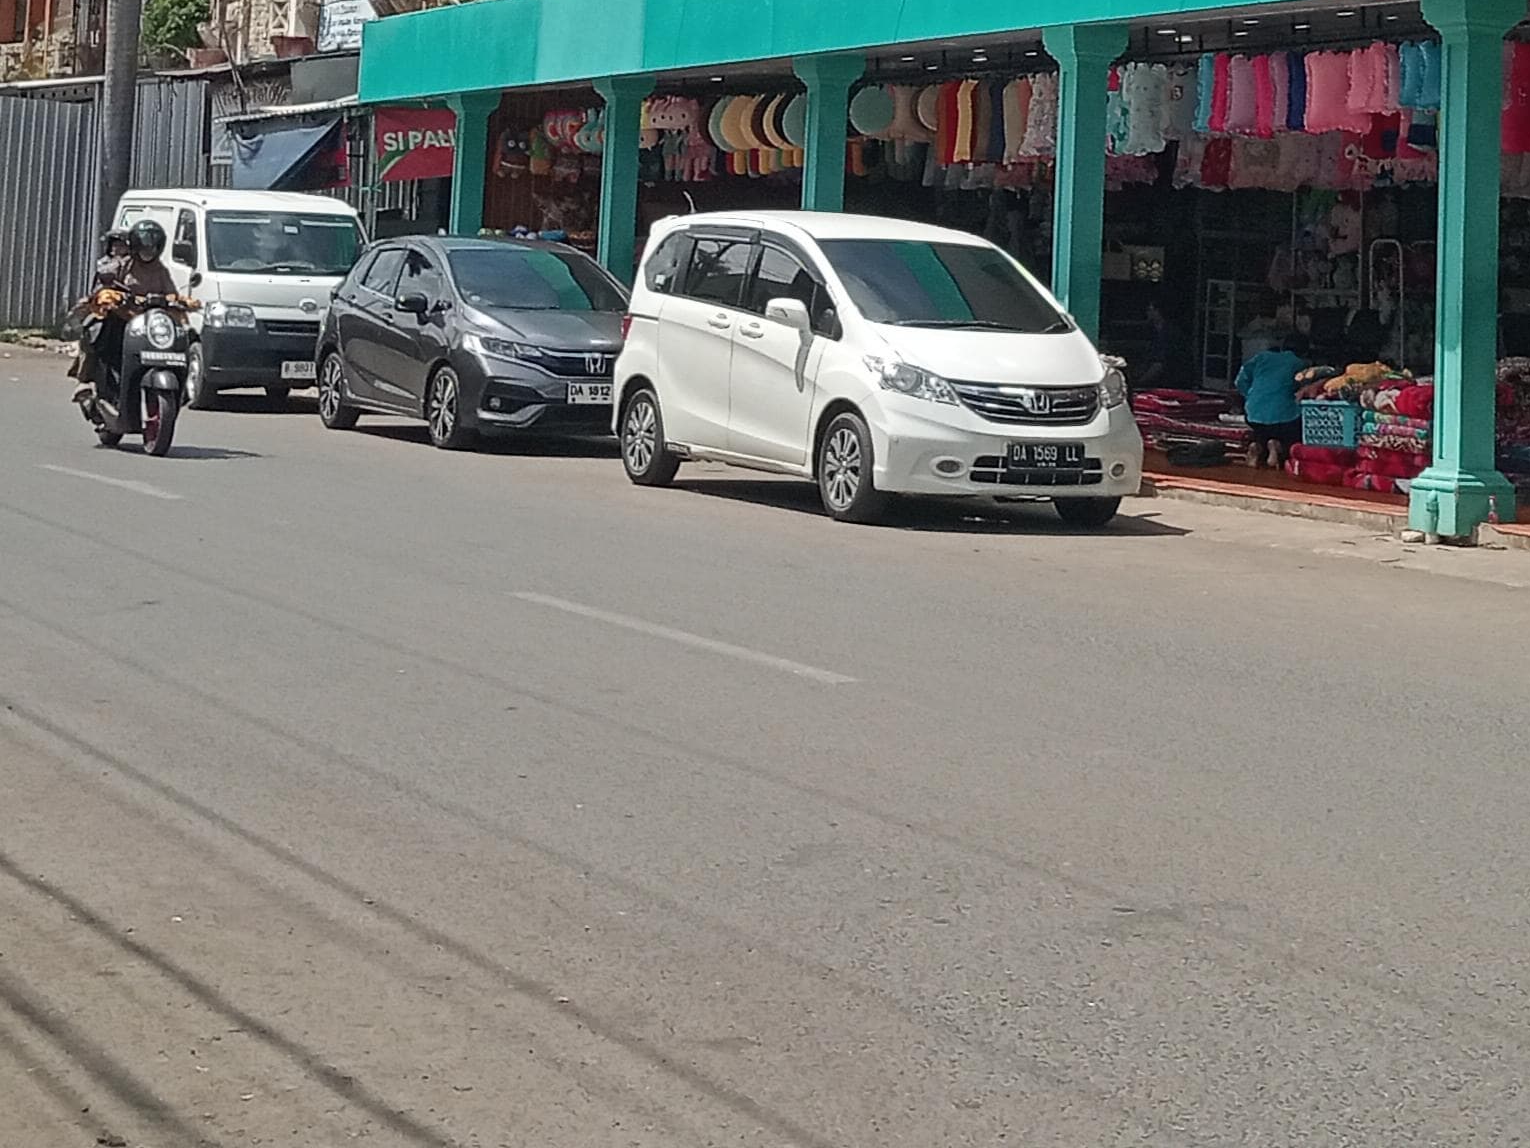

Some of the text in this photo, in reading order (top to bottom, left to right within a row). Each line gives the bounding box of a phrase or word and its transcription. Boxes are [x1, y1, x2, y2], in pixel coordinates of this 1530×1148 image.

[570, 384, 584, 396] DA
[1013, 445, 1080, 462] DA 1569 LL
